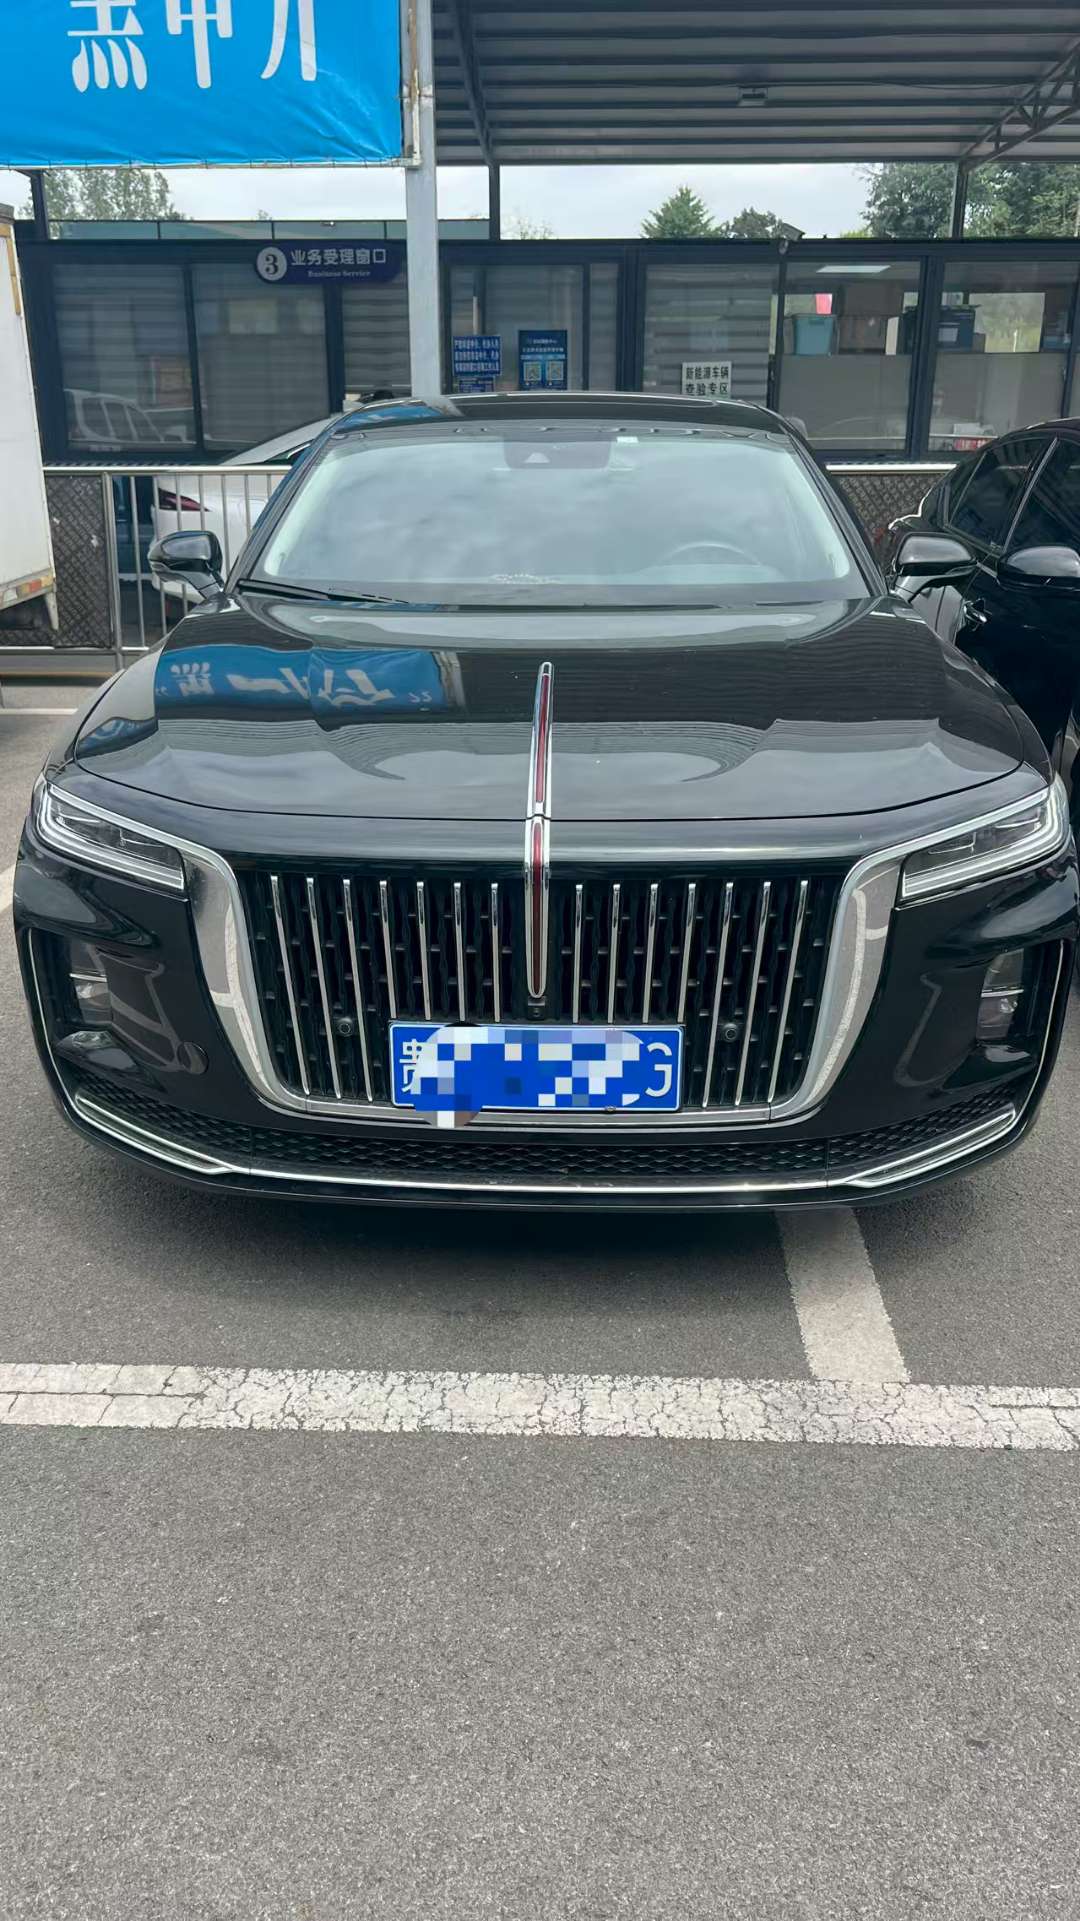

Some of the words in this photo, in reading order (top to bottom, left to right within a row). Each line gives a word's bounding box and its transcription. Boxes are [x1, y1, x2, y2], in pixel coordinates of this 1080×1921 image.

[265, 254, 279, 275] 3
[291, 248, 386, 266] 业务受理窗口
[686, 366, 729, 379] 新能源车辆
[686, 382, 729, 396] 查验专区
